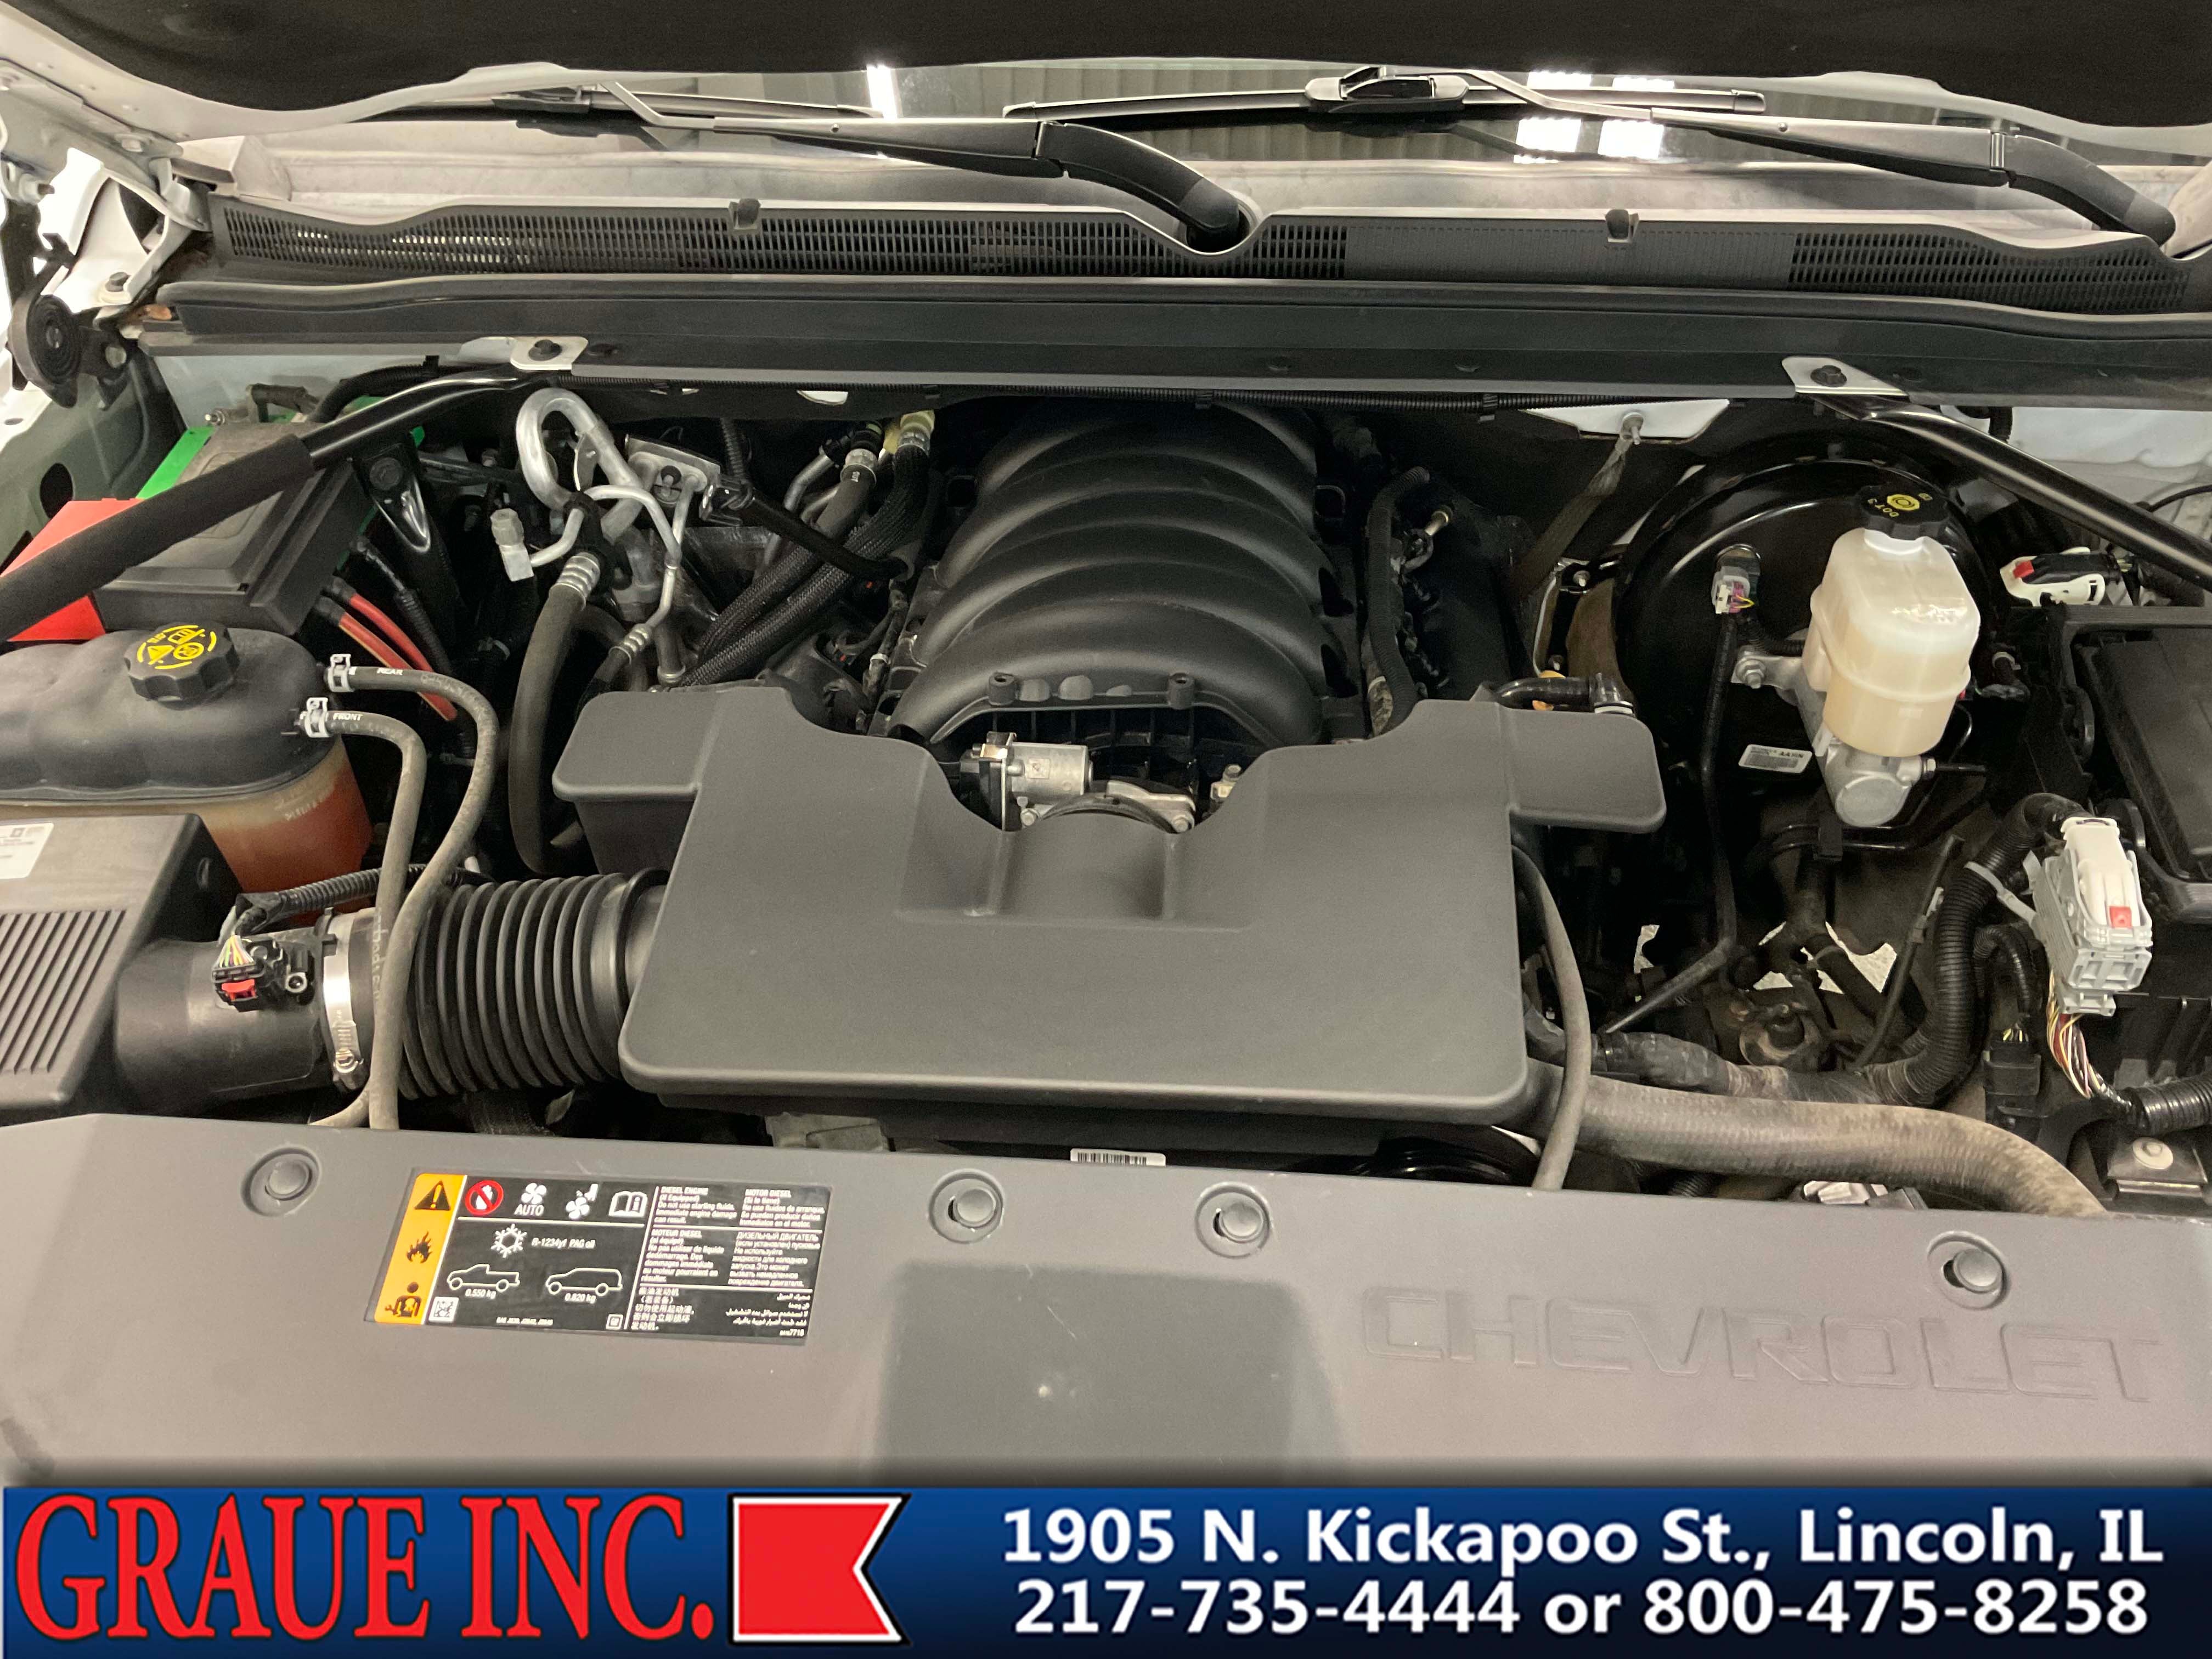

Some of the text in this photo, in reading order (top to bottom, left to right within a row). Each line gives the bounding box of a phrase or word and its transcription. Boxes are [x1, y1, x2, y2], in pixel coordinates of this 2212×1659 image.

[1874, 504, 1900, 517] DOT
[377, 668, 403, 676] REAR
[333, 713, 363, 721] FRONT
[514, 1204, 544, 1216] AUTO
[691, 1203, 715, 1211] starting
[712, 1210, 737, 1220] damage
[569, 1239, 585, 1248] PAG
[585, 1239, 596, 1248] oil
[465, 1289, 496, 1299] 0.550 kg
[586, 1294, 596, 1304] kg
[1362, 1285, 2162, 1403] CHEVROLET
